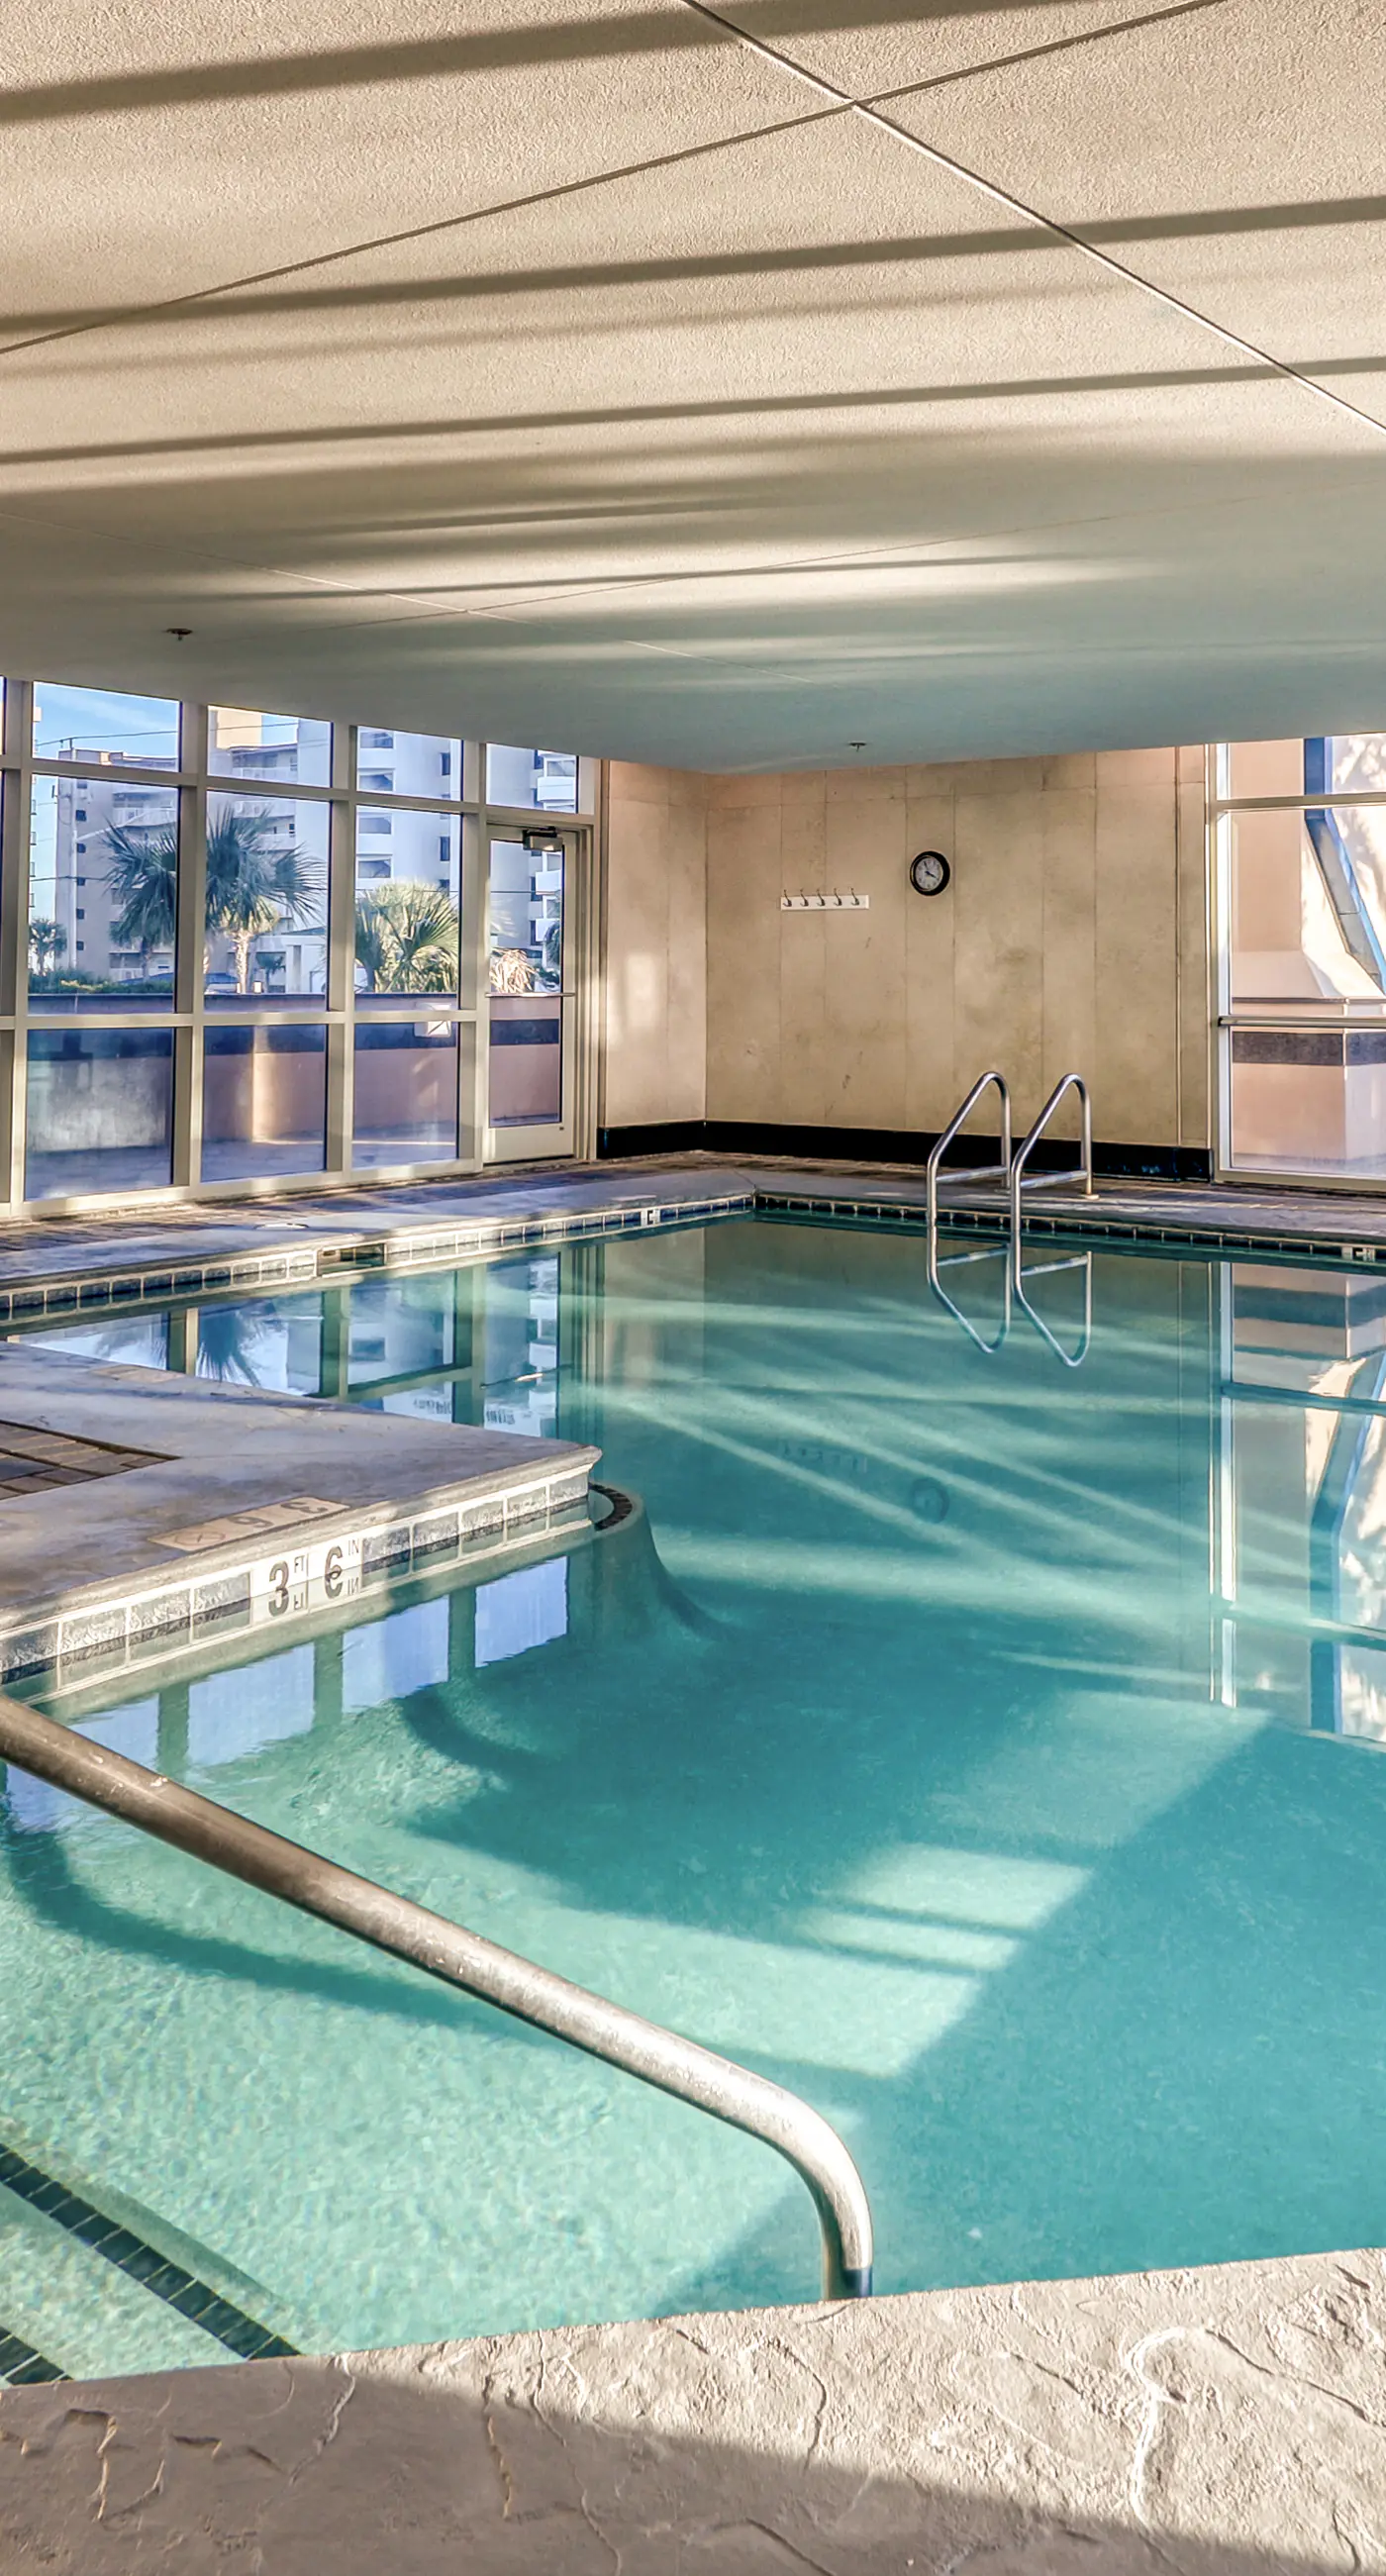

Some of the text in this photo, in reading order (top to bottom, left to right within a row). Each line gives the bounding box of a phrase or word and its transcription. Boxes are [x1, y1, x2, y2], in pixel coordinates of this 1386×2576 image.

[268, 1560, 289, 1618] 3
[294, 1554, 305, 1573] FT
[347, 1539, 359, 1556] IN
